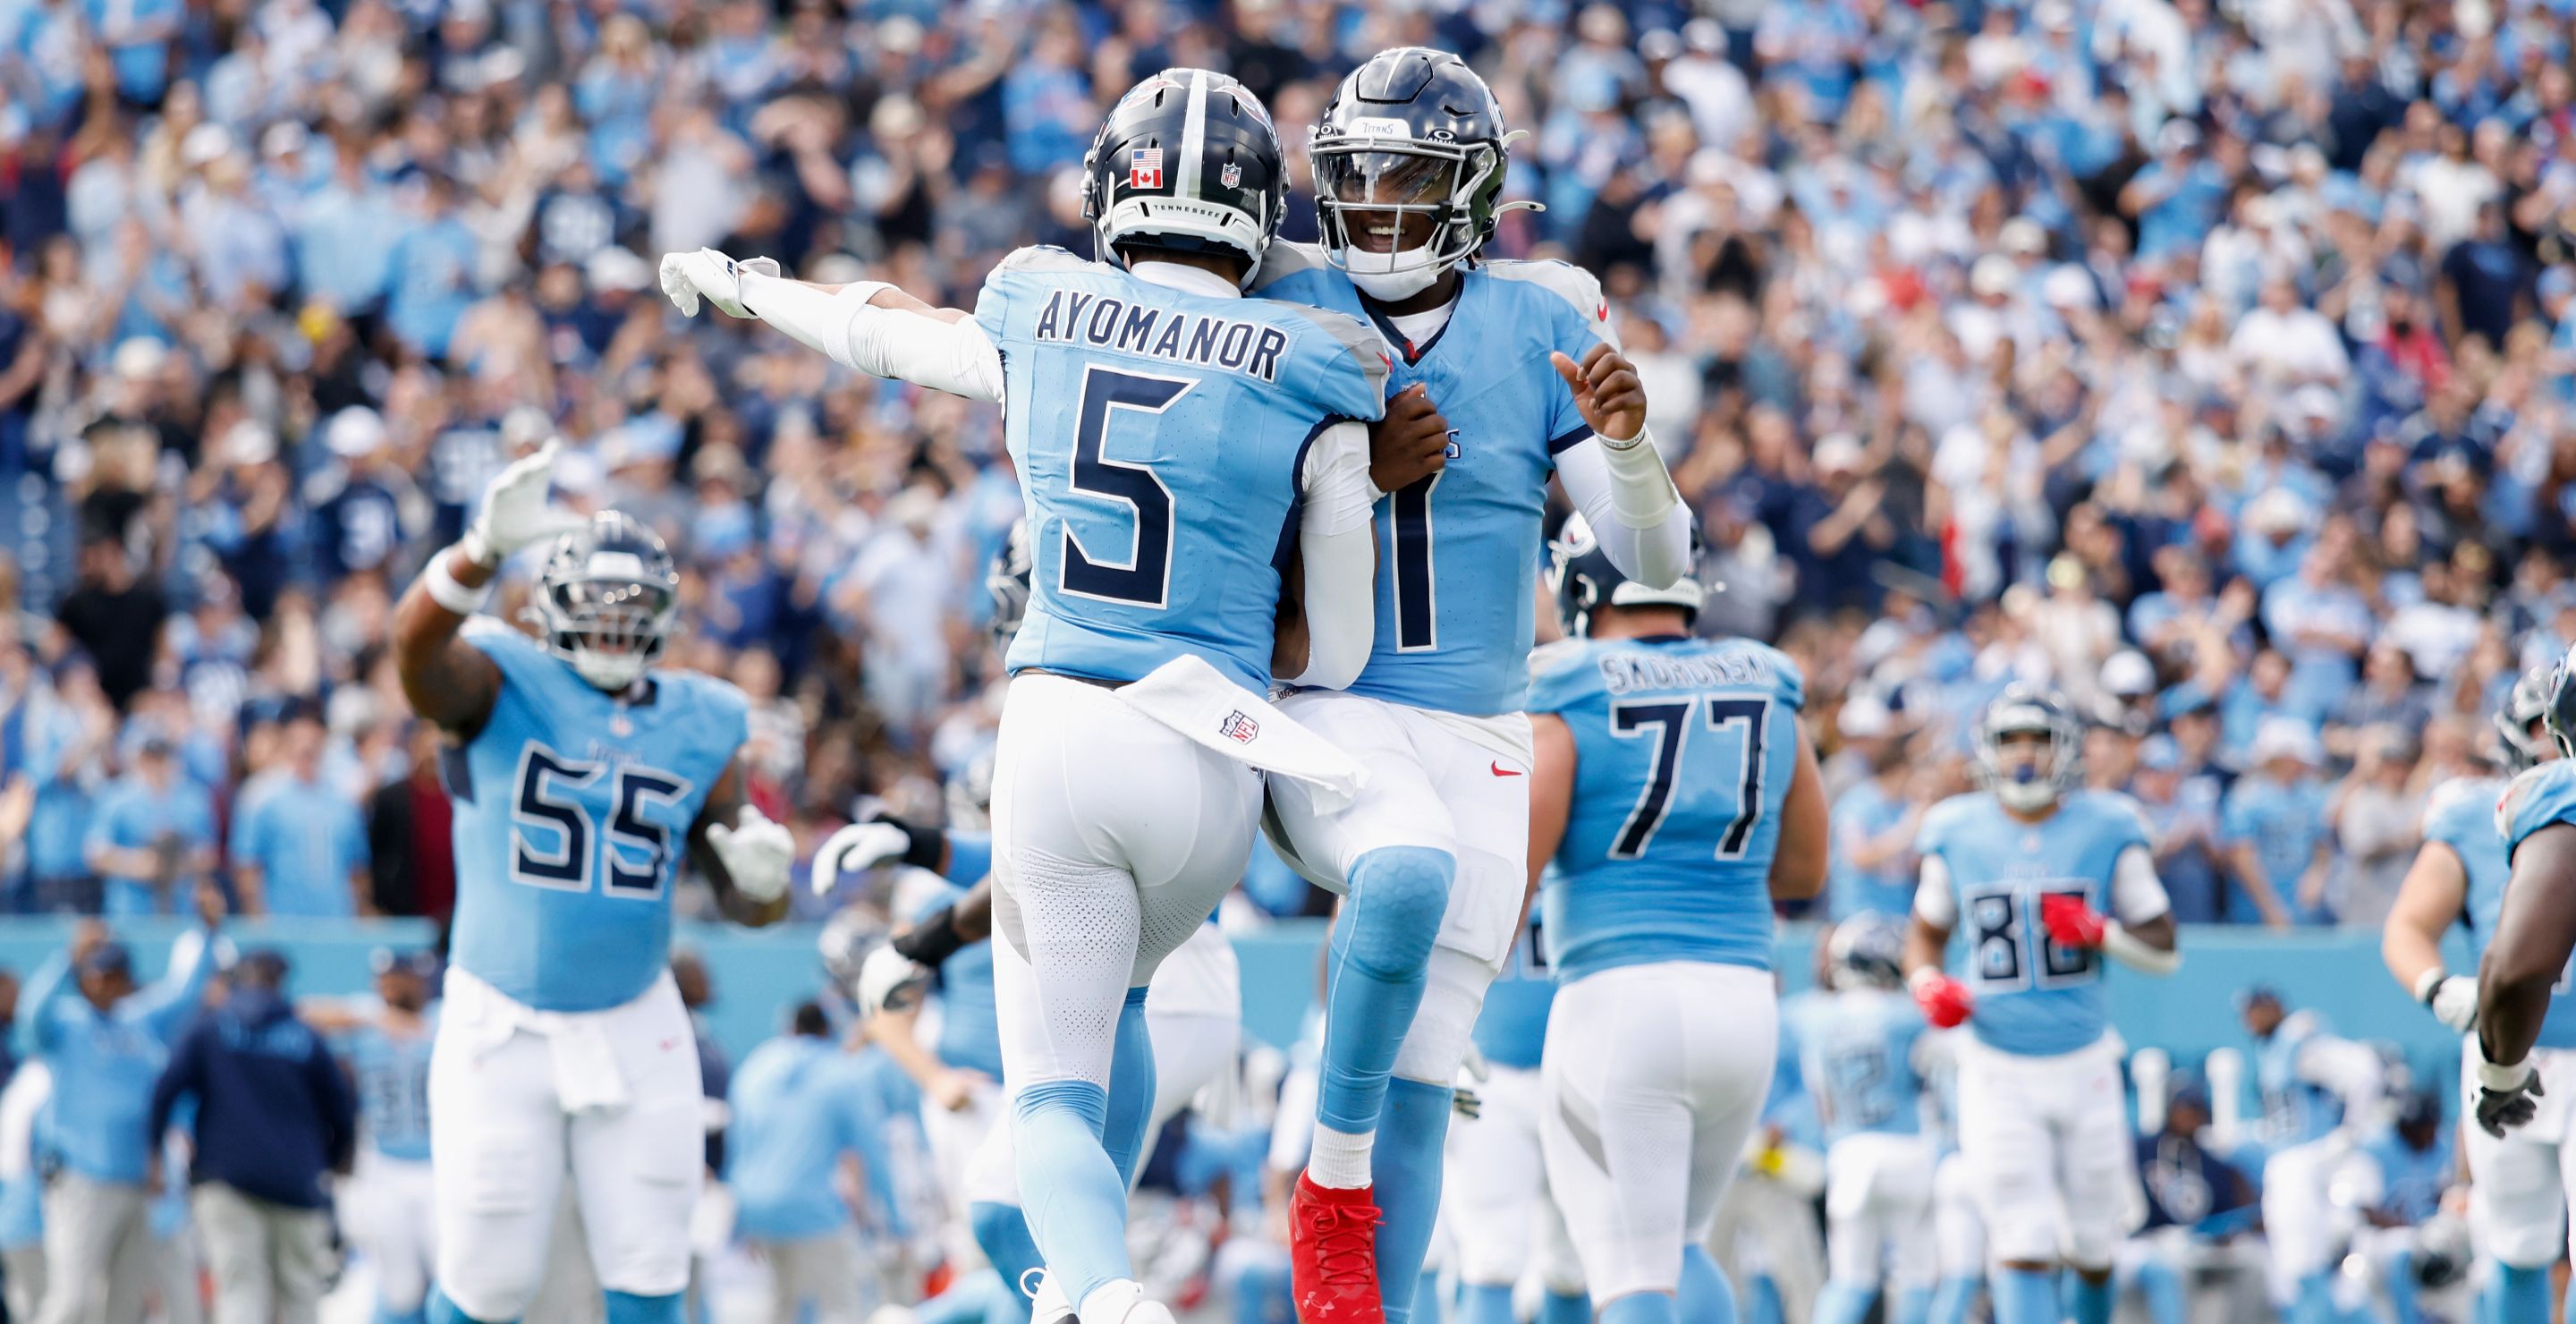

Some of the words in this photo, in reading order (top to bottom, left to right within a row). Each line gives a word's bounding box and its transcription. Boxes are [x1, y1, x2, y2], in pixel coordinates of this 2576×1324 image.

[1154, 205, 1220, 217] TENNESSEE
[1224, 173, 1239, 185] NFL
[1034, 288, 1288, 384] AYOMANOR
[1058, 361, 1201, 610] 5
[1233, 720, 1257, 743] NFL
[1607, 694, 1774, 861] 77
[510, 740, 694, 901] 55
